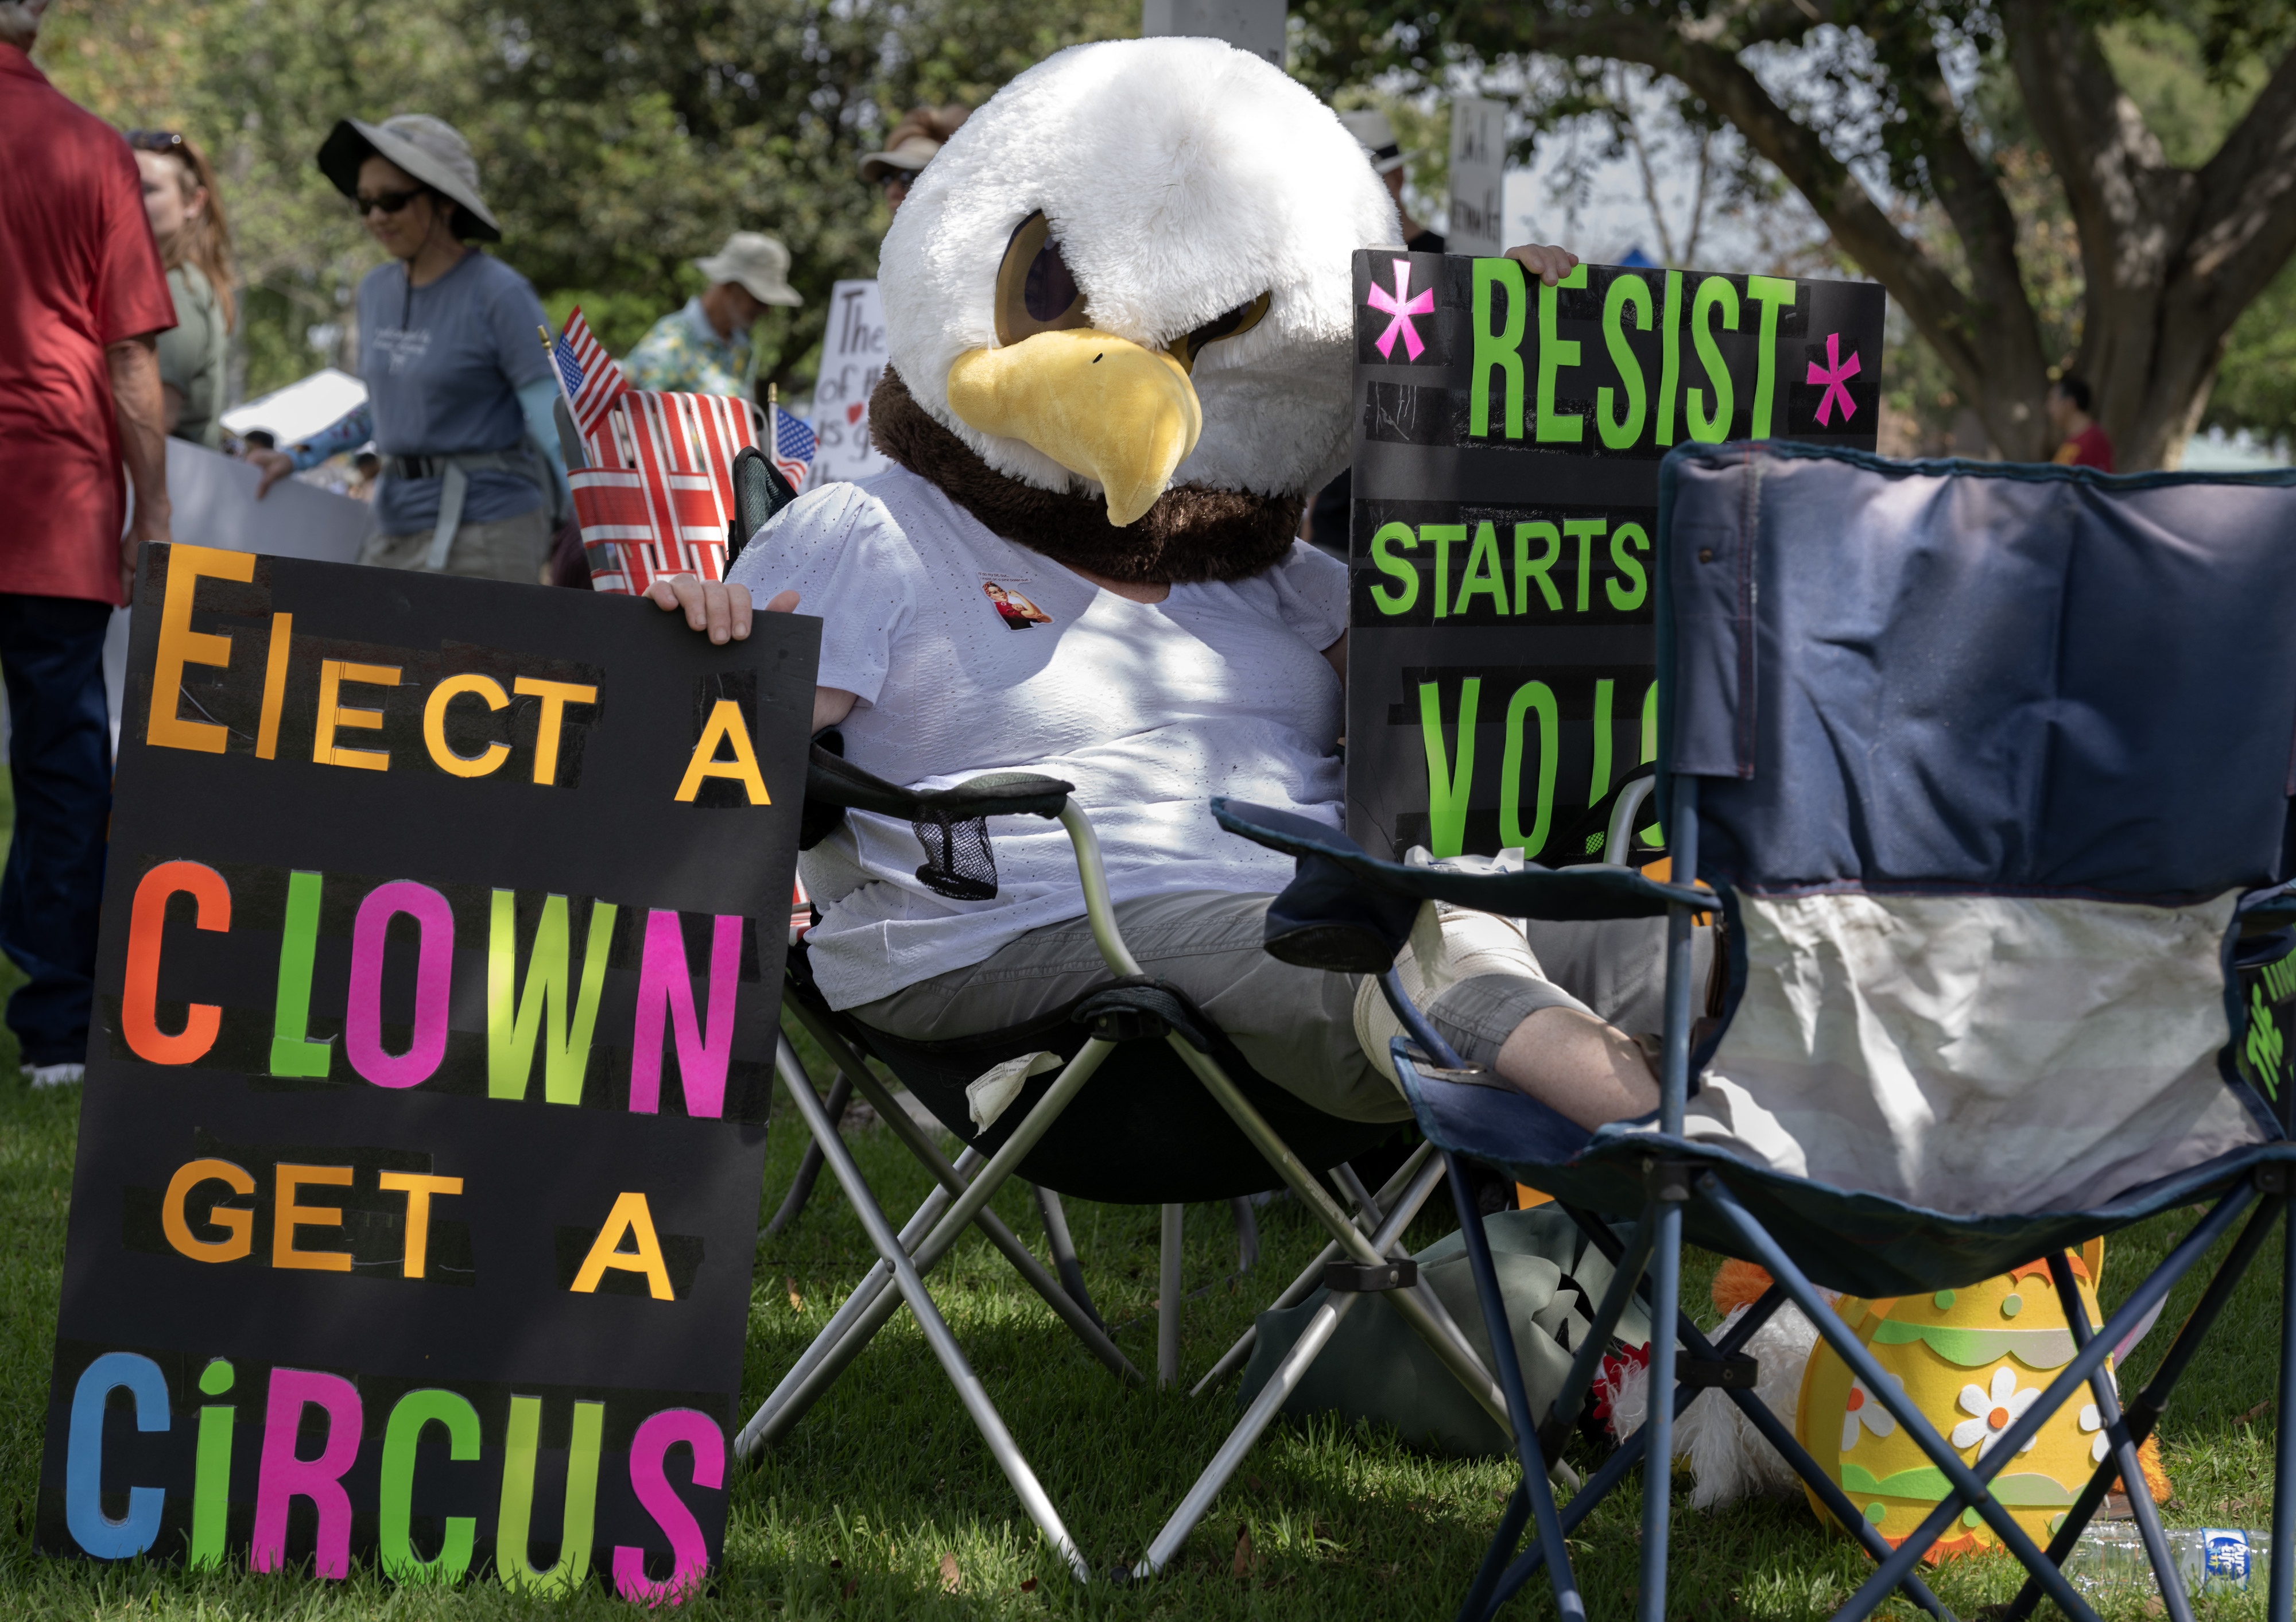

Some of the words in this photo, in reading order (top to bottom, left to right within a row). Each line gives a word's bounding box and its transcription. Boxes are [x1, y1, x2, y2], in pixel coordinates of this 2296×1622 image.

[837, 288, 885, 355] The
[1469, 257, 1797, 450] RESIST
[817, 362, 860, 407] of
[1370, 518, 1650, 618] STARTS
[673, 699, 772, 806] A
[121, 860, 743, 1119] CLOWN
[162, 1158, 464, 1279] GET
[569, 1192, 675, 1302] A
[2219, 1543, 2235, 1570] Life
[2233, 1543, 2250, 1574] Pure
